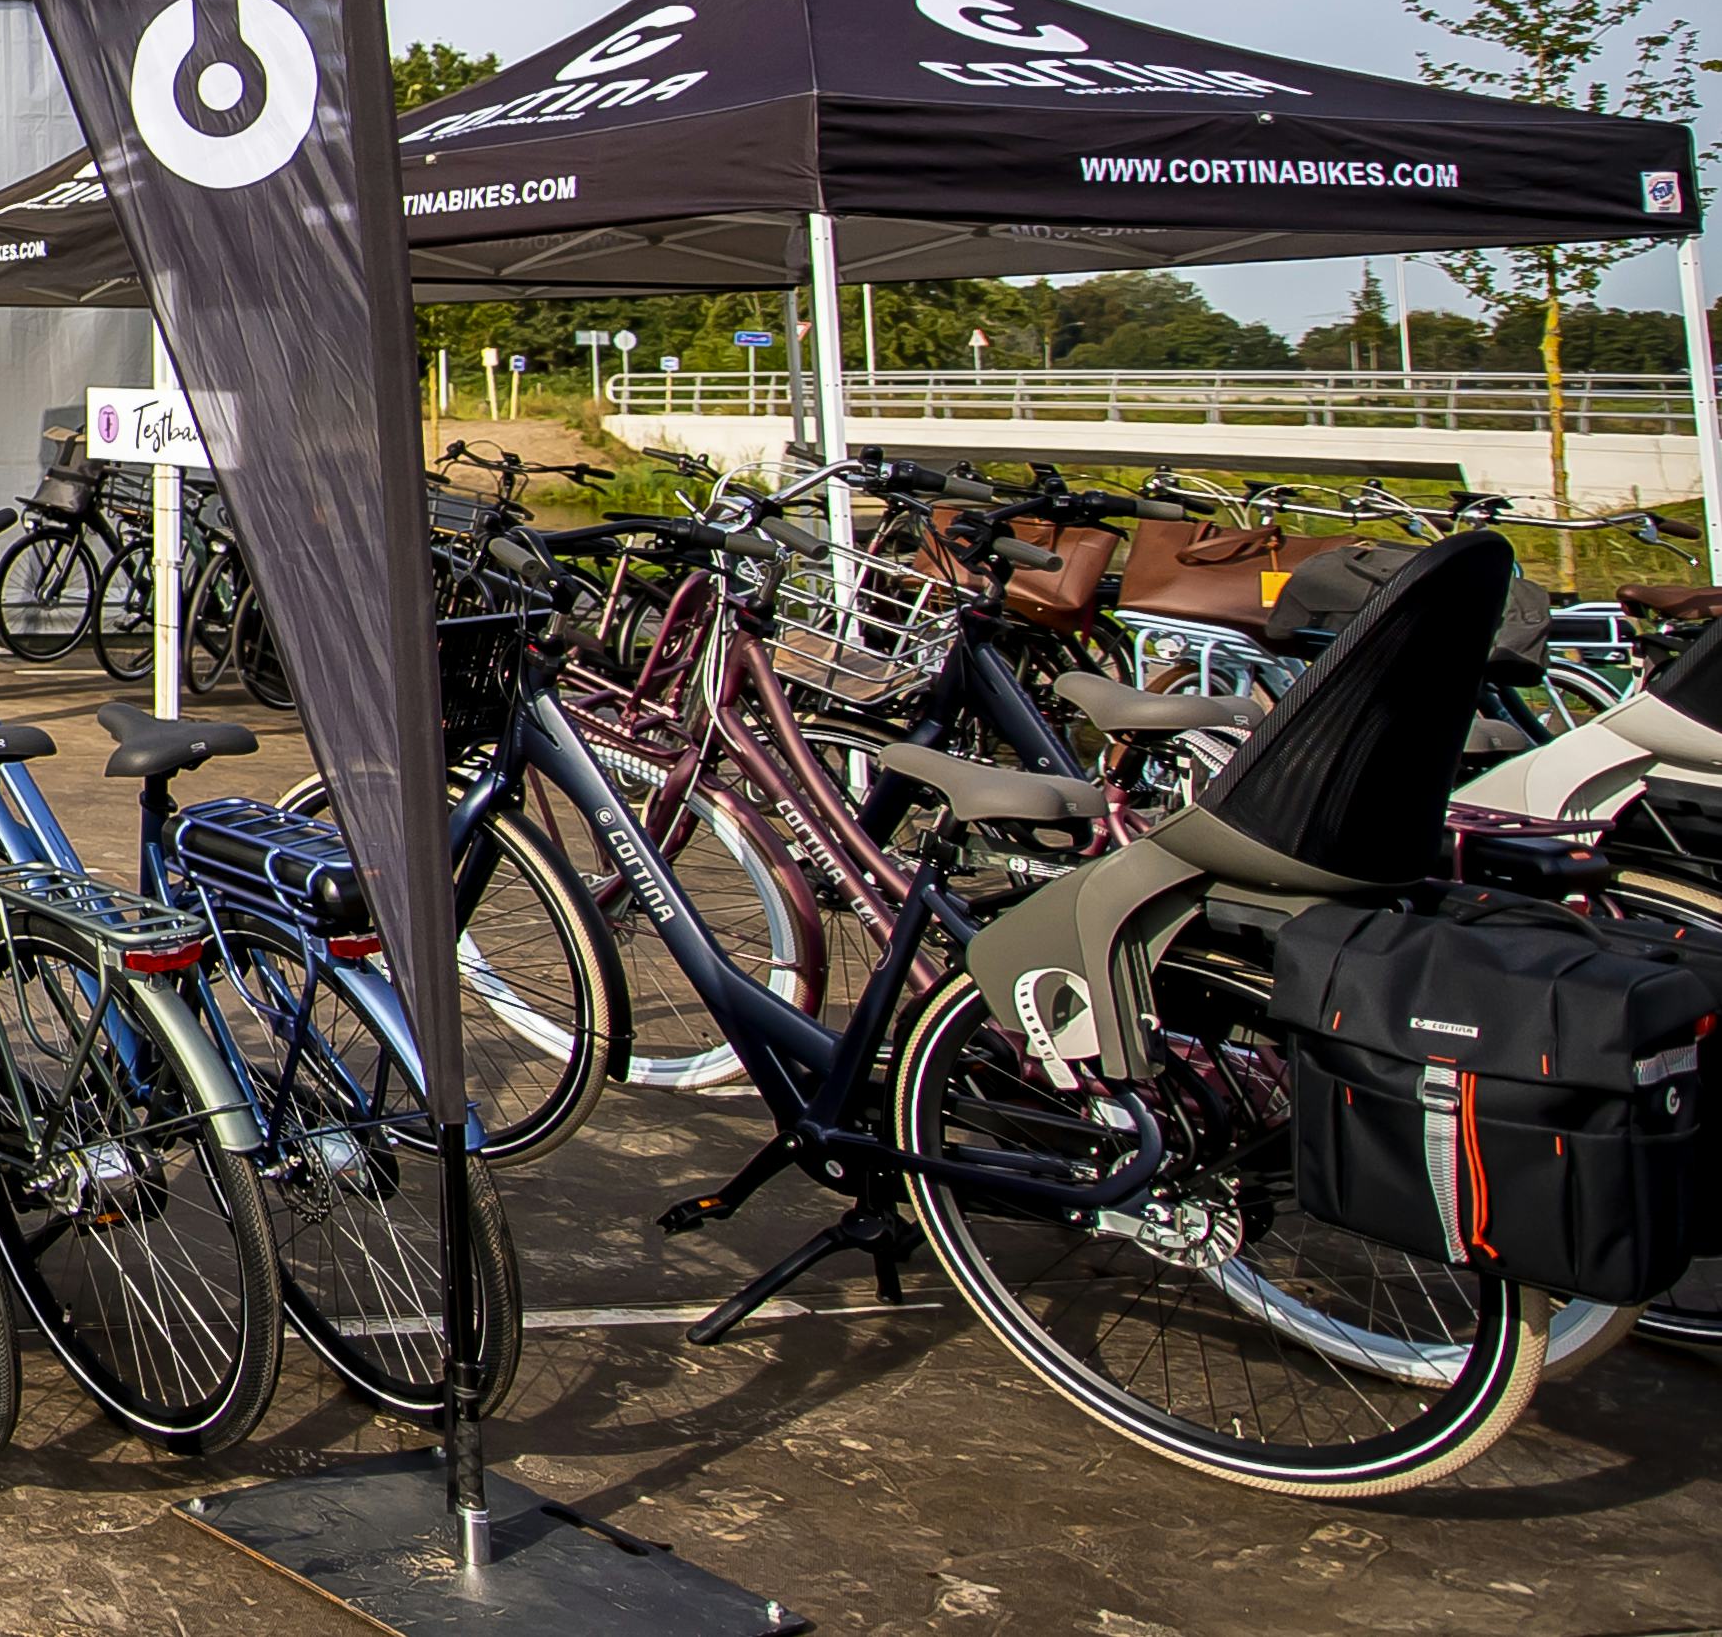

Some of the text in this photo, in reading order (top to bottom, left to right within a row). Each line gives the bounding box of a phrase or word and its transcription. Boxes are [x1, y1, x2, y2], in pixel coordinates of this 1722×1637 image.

[402, 175, 576, 216] TINABIKES.COM
[1080, 156, 1459, 189] WWW.CORTINABIKES.COM
[133, 400, 198, 453] Testba
[776, 799, 847, 885] CORTINA
[608, 830, 675, 923] CORTINA
